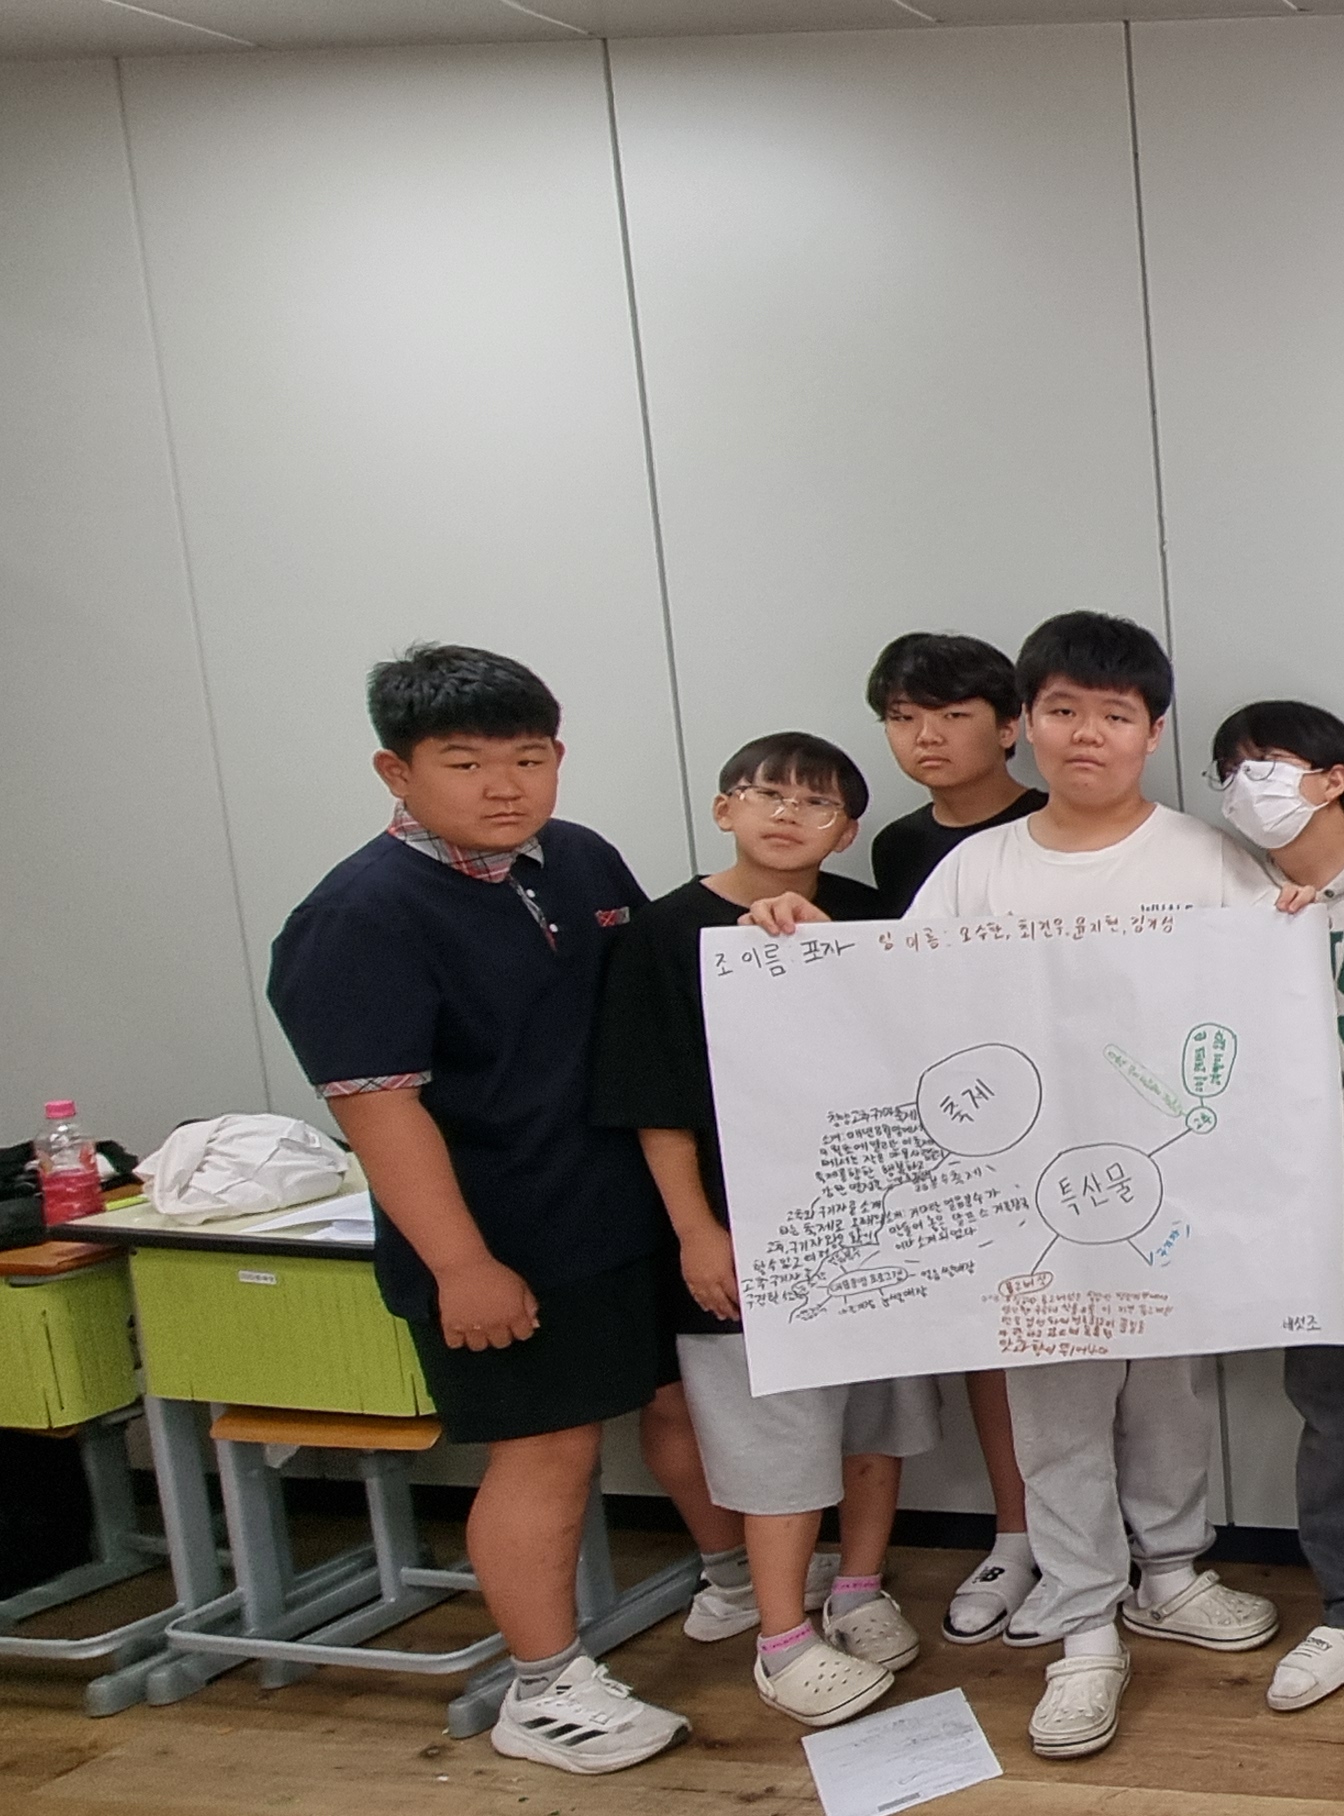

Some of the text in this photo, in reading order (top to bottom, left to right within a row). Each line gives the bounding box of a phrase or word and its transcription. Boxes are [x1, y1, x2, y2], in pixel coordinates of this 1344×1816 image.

[716, 953, 733, 977] 조
[800, 939, 856, 964] 포자
[938, 1078, 996, 1124] 축제
[1058, 1162, 1135, 1216] 특산물
